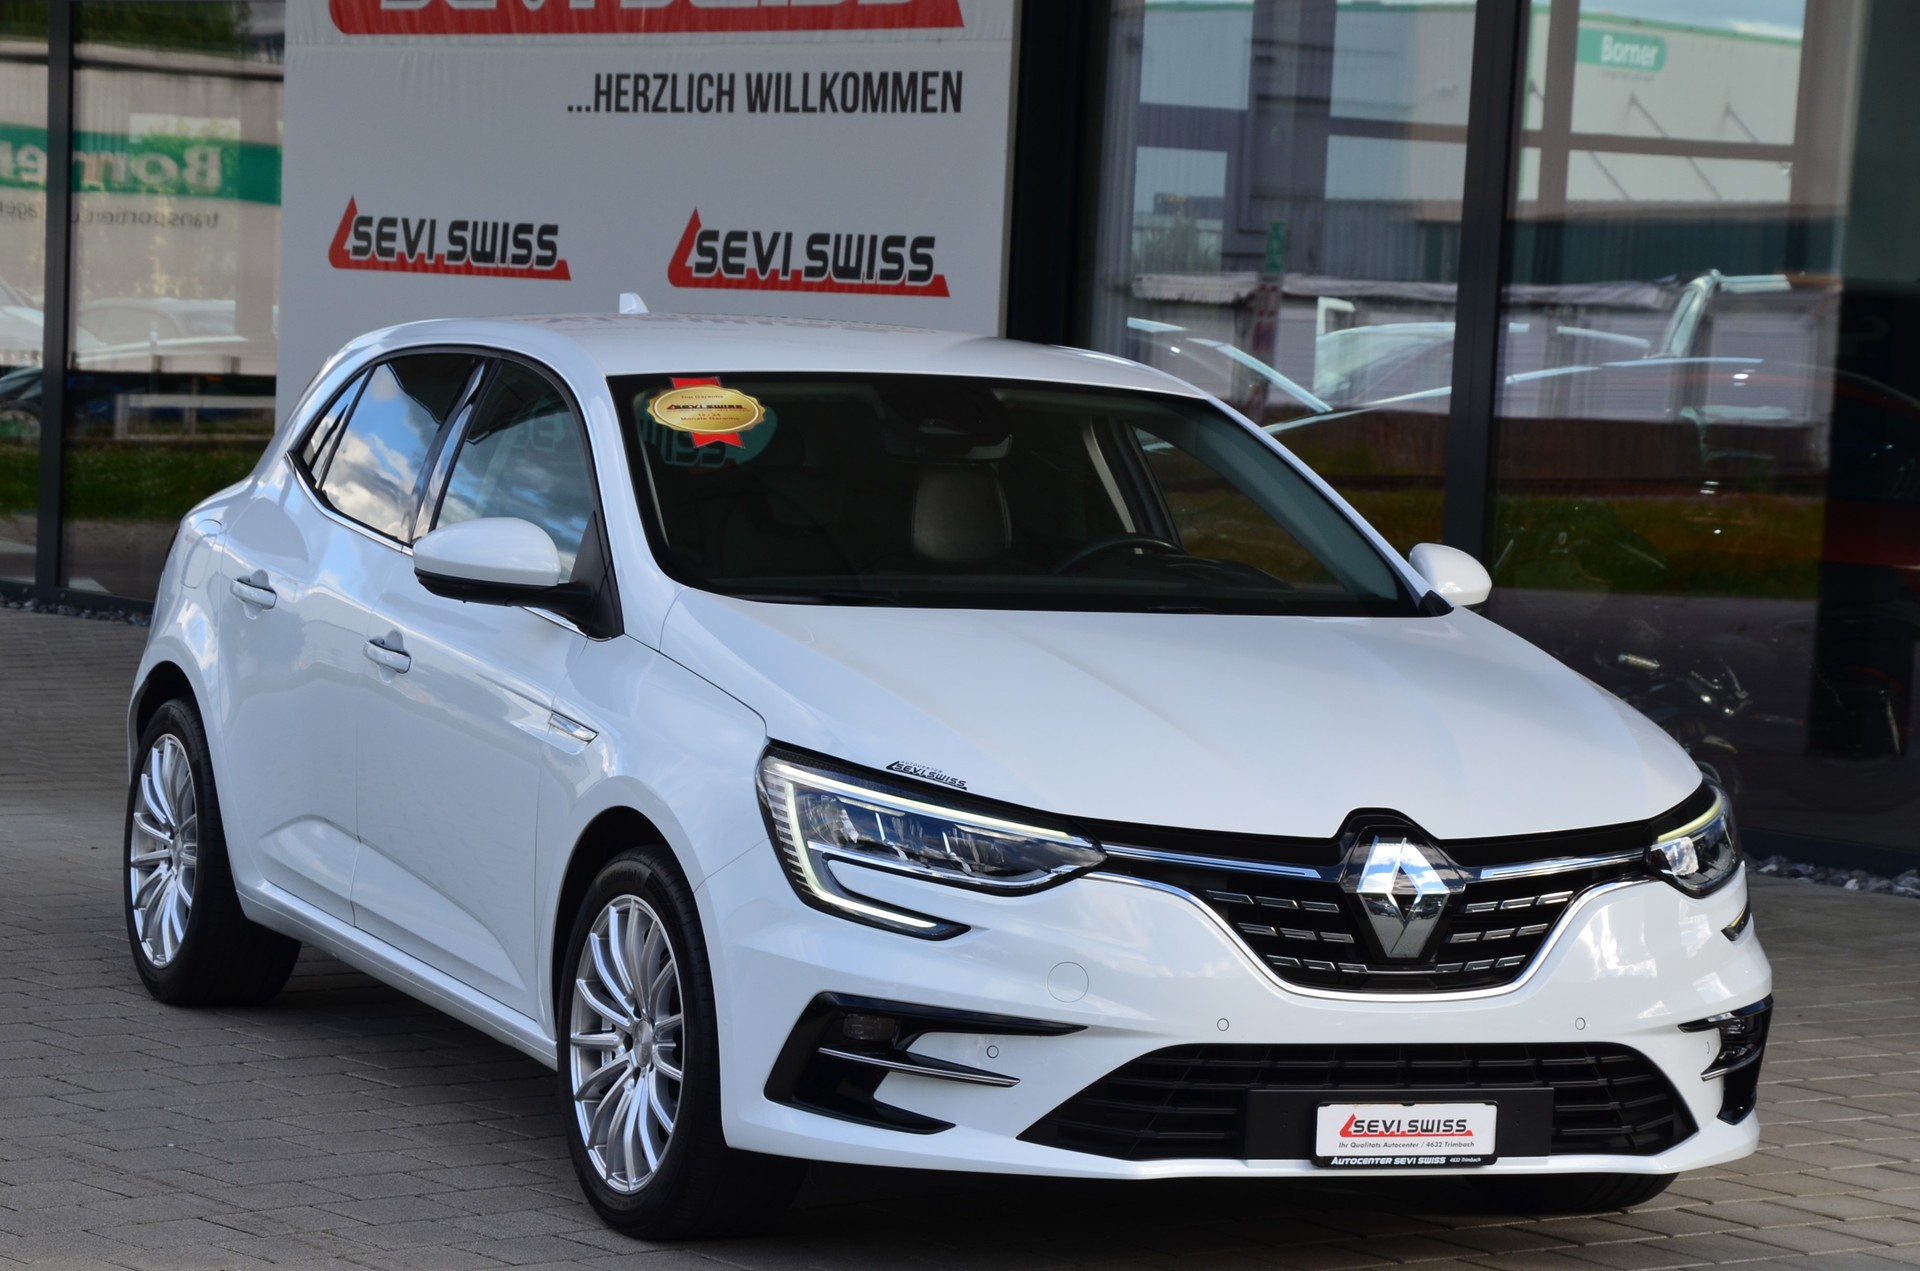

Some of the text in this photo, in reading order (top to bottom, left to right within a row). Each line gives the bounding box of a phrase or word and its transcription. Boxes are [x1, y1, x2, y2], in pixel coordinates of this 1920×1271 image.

[1601, 34, 1659, 67] Borner
[745, 70, 963, 114] WILLKOMMEN
[351, 215, 559, 268] SEVI SWISS
[694, 229, 936, 283] SEVI SWISS
[895, 763, 967, 787] SEVI SWISS
[1353, 1119, 1467, 1133] SEVI SWISS
[1393, 1156, 1417, 1165] SEVI
[1417, 1156, 1447, 1165] SWISS
